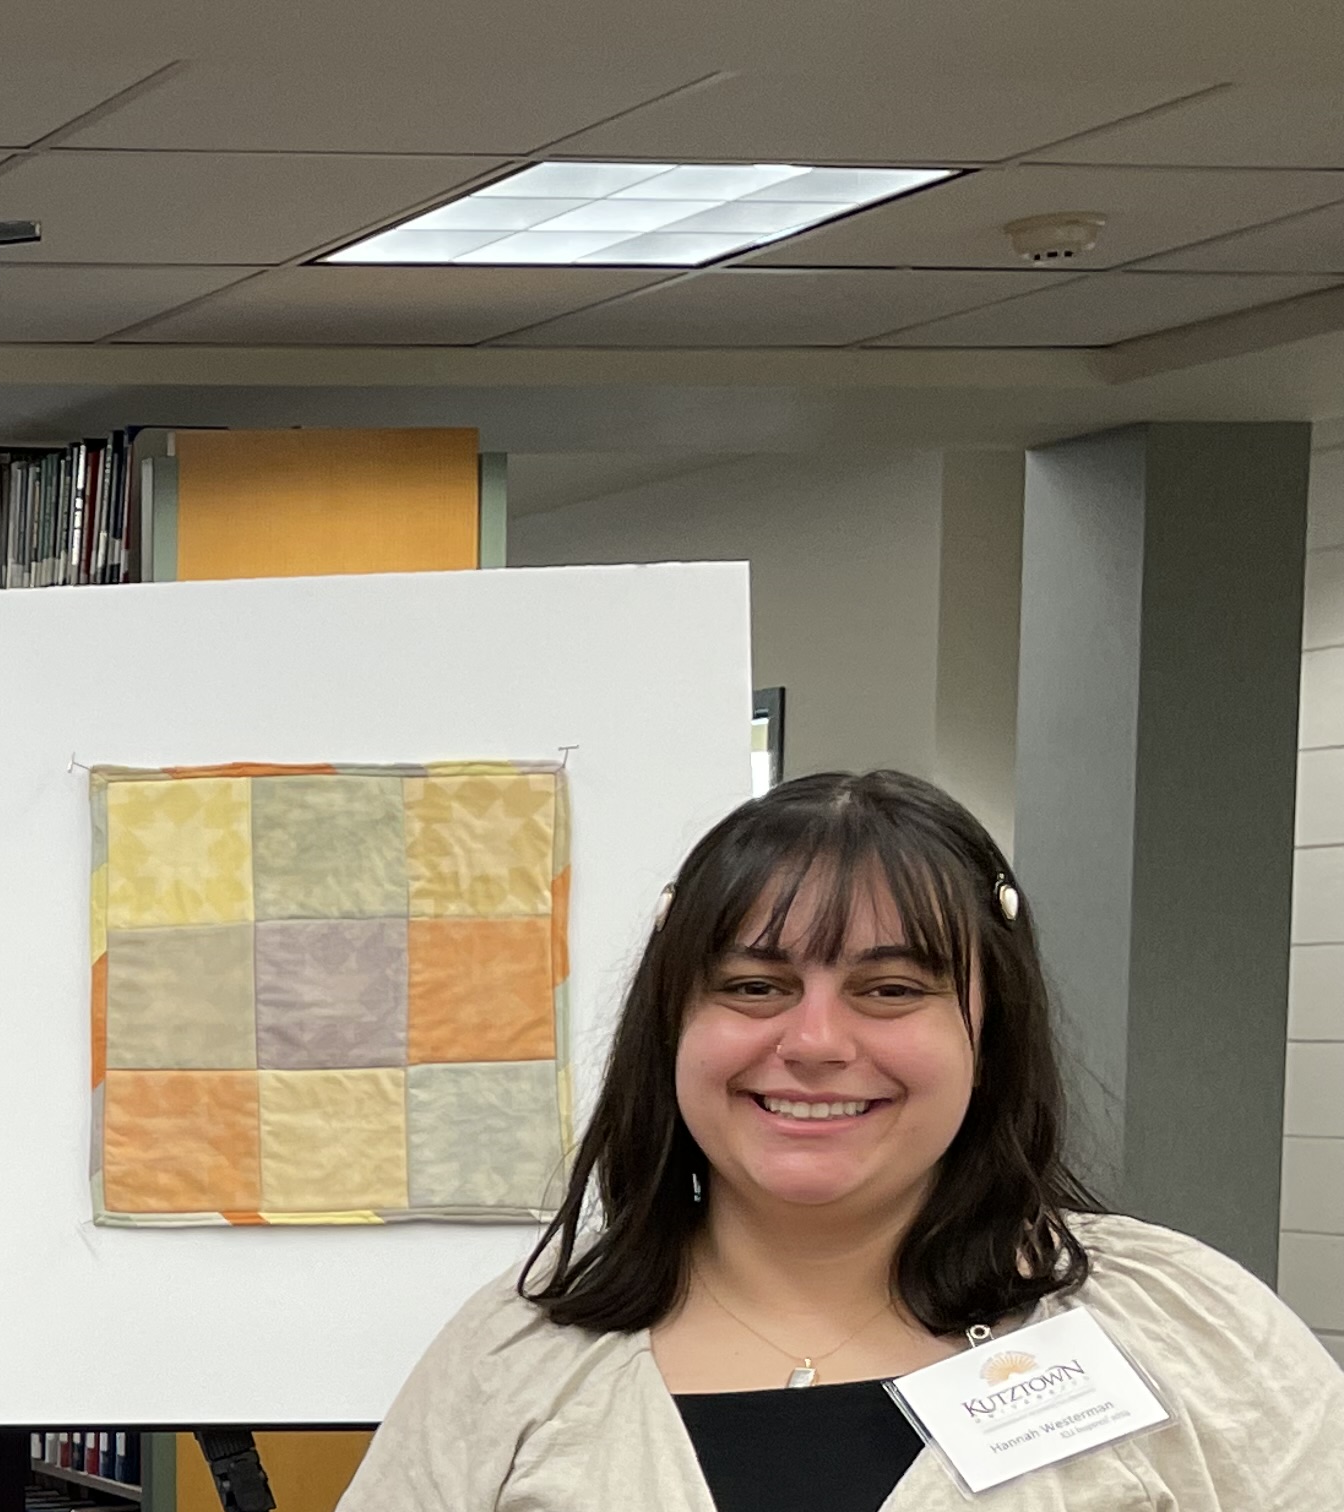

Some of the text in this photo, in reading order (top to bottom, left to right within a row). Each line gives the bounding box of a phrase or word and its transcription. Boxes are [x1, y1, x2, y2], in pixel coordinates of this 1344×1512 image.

[962, 1359, 1085, 1417] KUTZTOWN
[990, 1429, 1040, 1453] Hannah
[1041, 1401, 1114, 1433] Westerman
